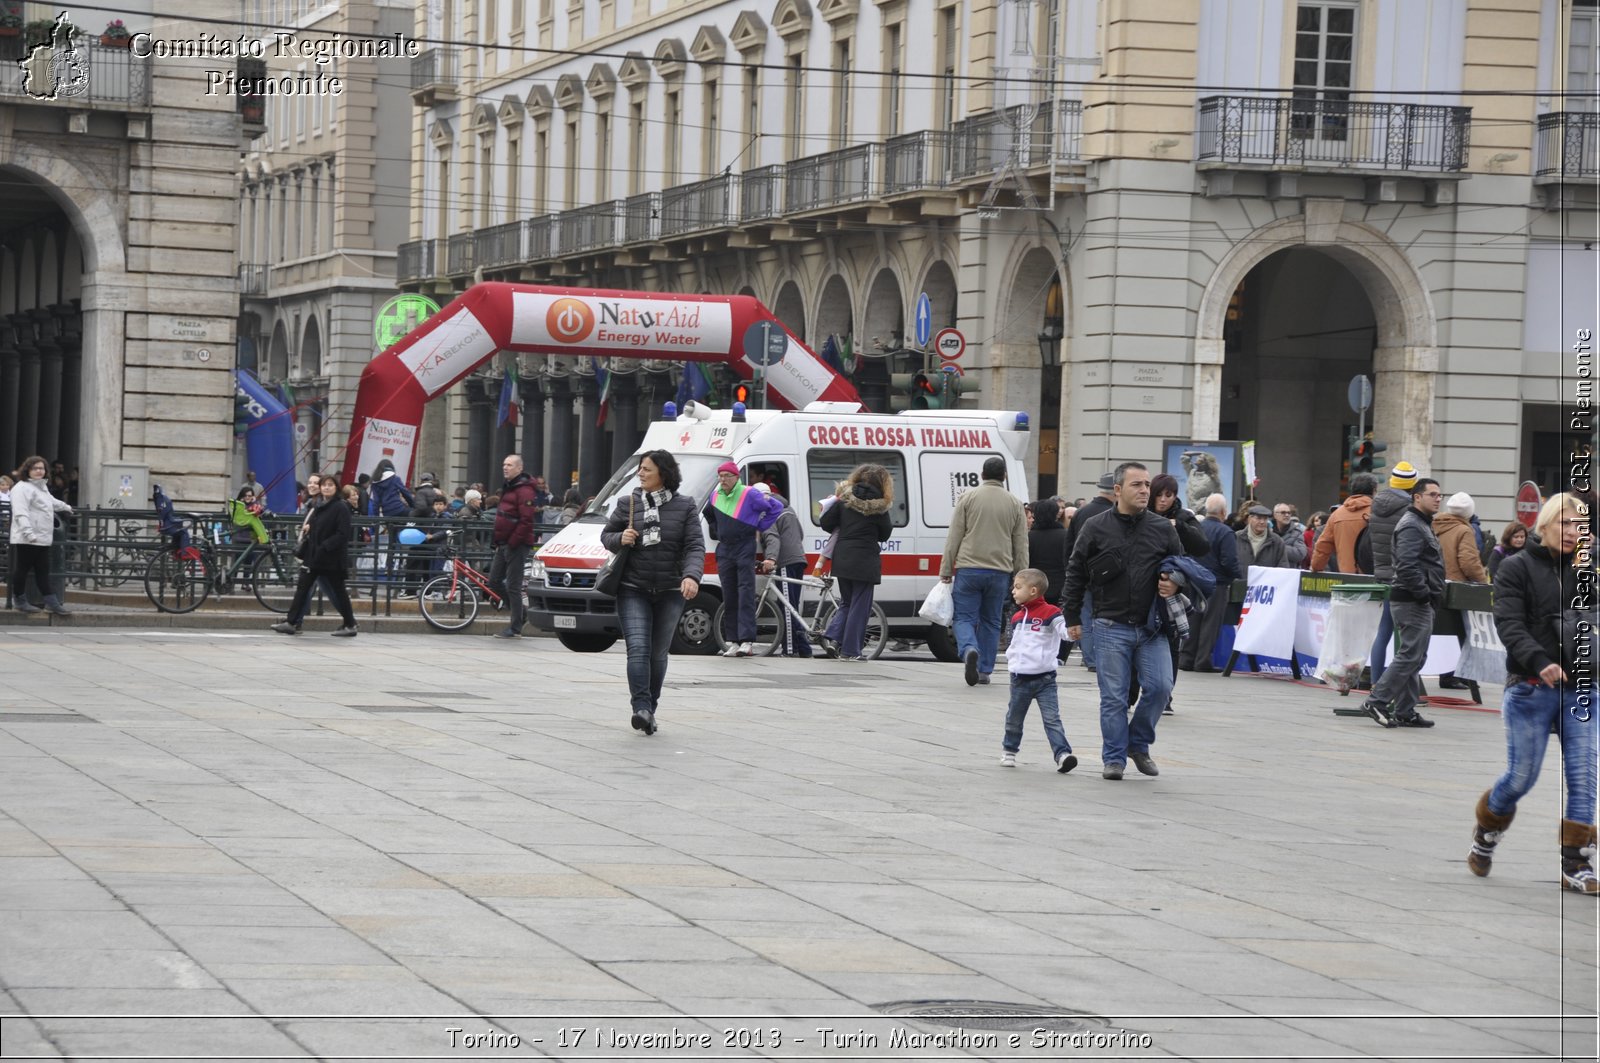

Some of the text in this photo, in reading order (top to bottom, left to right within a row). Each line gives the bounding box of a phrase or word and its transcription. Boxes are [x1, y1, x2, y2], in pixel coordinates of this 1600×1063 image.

[599, 302, 701, 328] NaturAid
[172, 329, 207, 337] CASTELLO
[597, 330, 701, 345] Energy Water
[435, 329, 482, 366] ABEKOM
[713, 427, 728, 437] 118
[808, 425, 992, 448] CROCE ROSSA ITALIANA
[955, 472, 979, 487] 118
[881, 540, 902, 551] CRT
[1031, 617, 1043, 631] 2
